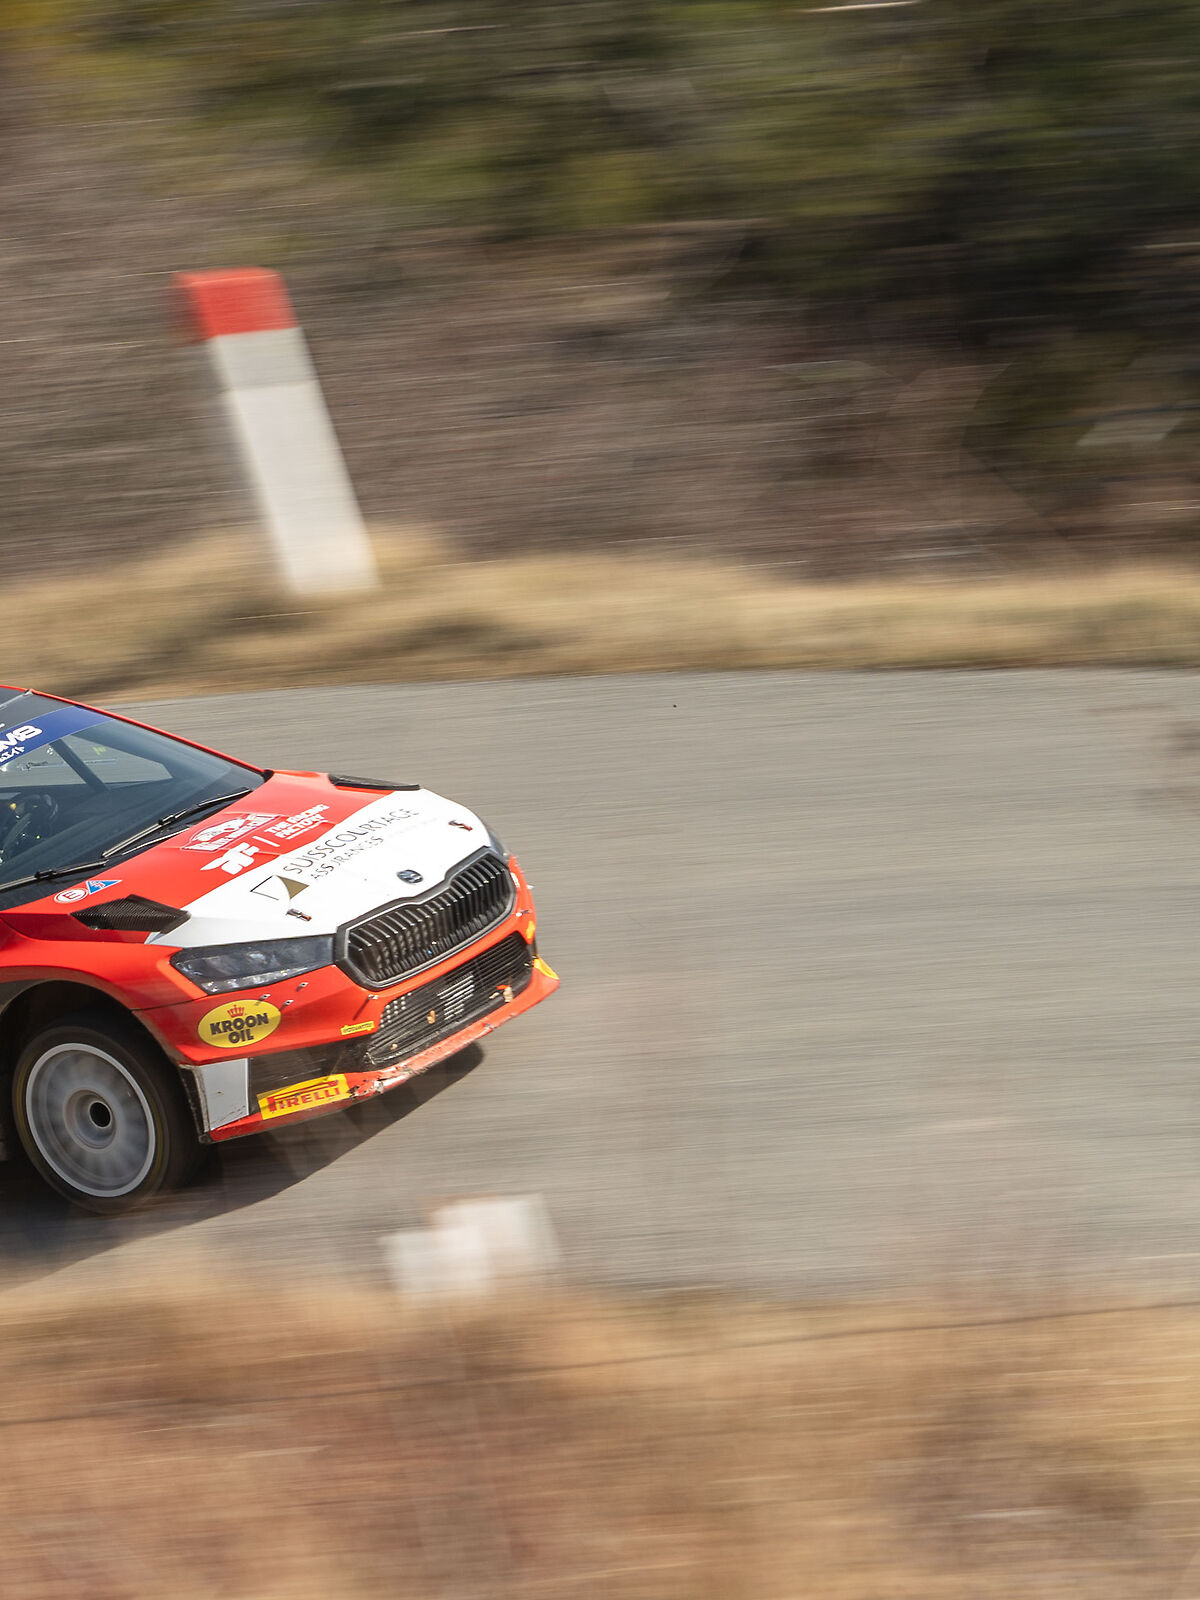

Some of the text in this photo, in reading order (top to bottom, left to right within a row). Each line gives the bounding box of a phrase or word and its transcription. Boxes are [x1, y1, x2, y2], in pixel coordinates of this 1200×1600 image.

[283, 809, 420, 874] SUISSCOURTAGE
[210, 1013, 269, 1035] KROON
[228, 1029, 254, 1044] OIL
[266, 1080, 339, 1112] PIRELLI
